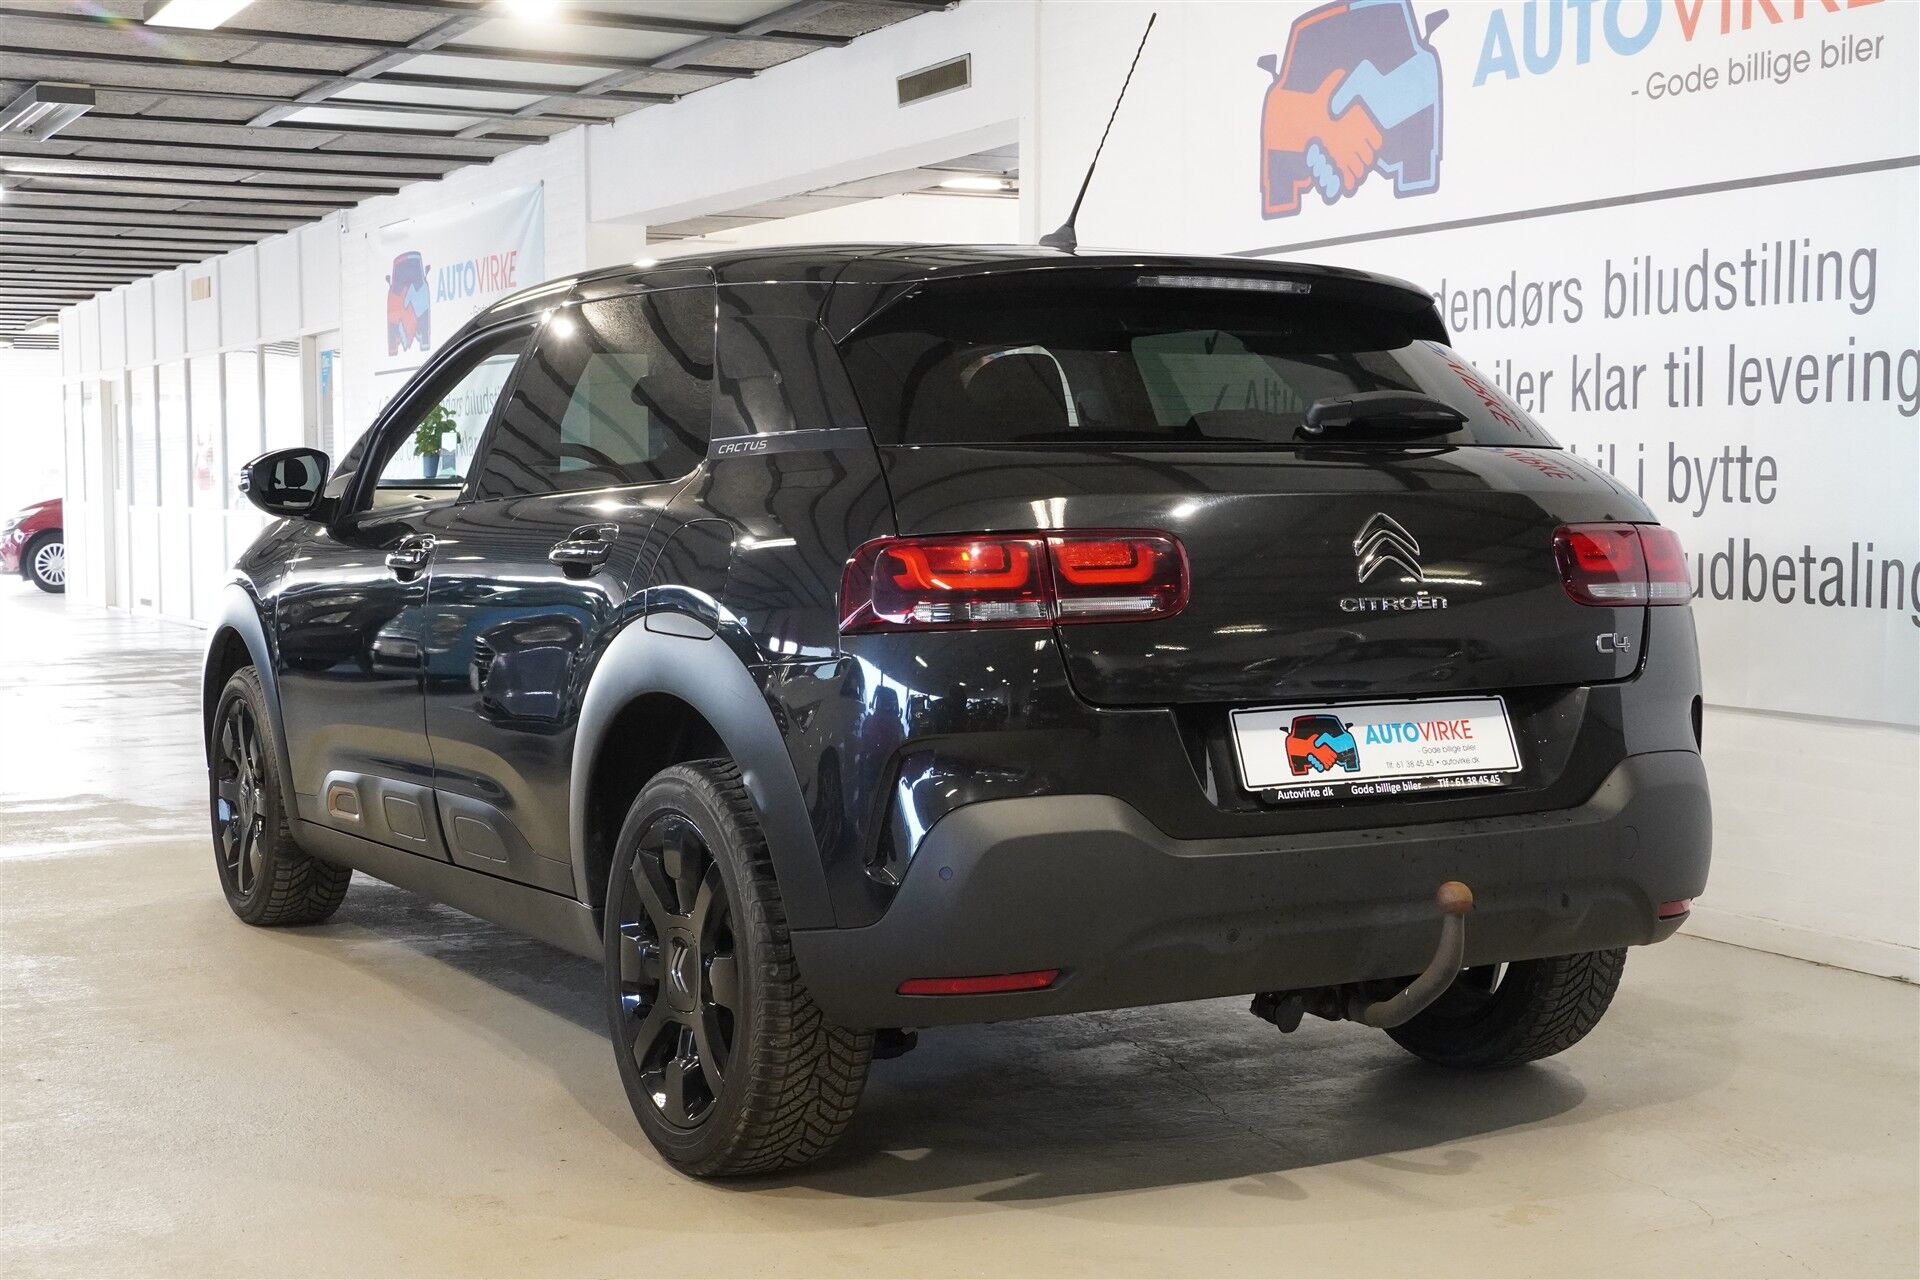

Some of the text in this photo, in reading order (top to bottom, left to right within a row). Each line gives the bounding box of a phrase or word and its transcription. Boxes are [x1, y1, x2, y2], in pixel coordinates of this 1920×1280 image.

[1646, 64, 1719, 100] Gode
[1728, 48, 1810, 85] billige
[1821, 34, 1885, 69] biler
[437, 250, 517, 303] AUTOVIRKE
[1604, 238, 1877, 315] biludstilling
[1571, 352, 1647, 412] klar
[1664, 346, 1704, 408] til
[1728, 336, 1920, 417] levering
[718, 440, 768, 454] CACTUS
[1668, 442, 1777, 517] bytte
[1596, 632, 1631, 653] C4
[1366, 720, 1473, 745] AUTOVIRKE
[1421, 744, 1476, 754] Gode billige biler
[1396, 761, 1404, 769] 61
[1407, 760, 1415, 768] 38
[1426, 759, 1434, 767] 45
[1351, 785, 1374, 795] Gode
[1375, 783, 1401, 794] billige
[1455, 777, 1465, 786] 61
[1467, 776, 1478, 785] 38
[1479, 775, 1489, 784] 45
[1490, 774, 1501, 784] 45
